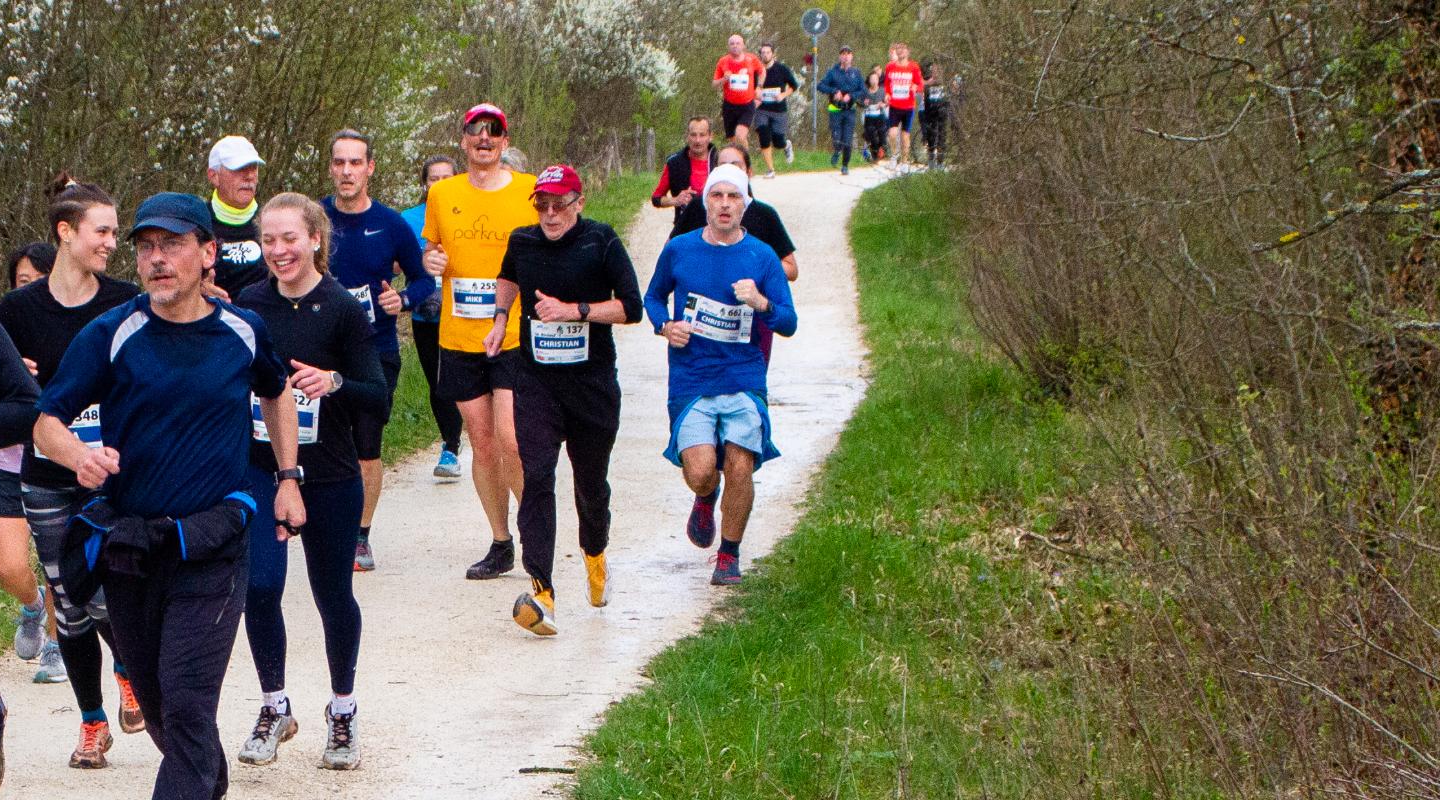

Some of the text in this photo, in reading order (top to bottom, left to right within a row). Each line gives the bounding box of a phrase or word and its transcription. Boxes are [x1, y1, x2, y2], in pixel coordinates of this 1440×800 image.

[480, 282, 497, 290] 255
[464, 295, 483, 303] MIKE
[701, 315, 737, 328] CHRISTIAN
[566, 325, 583, 334] 137
[539, 340, 580, 348] CHRISTIAN
[75, 410, 99, 421] 48
